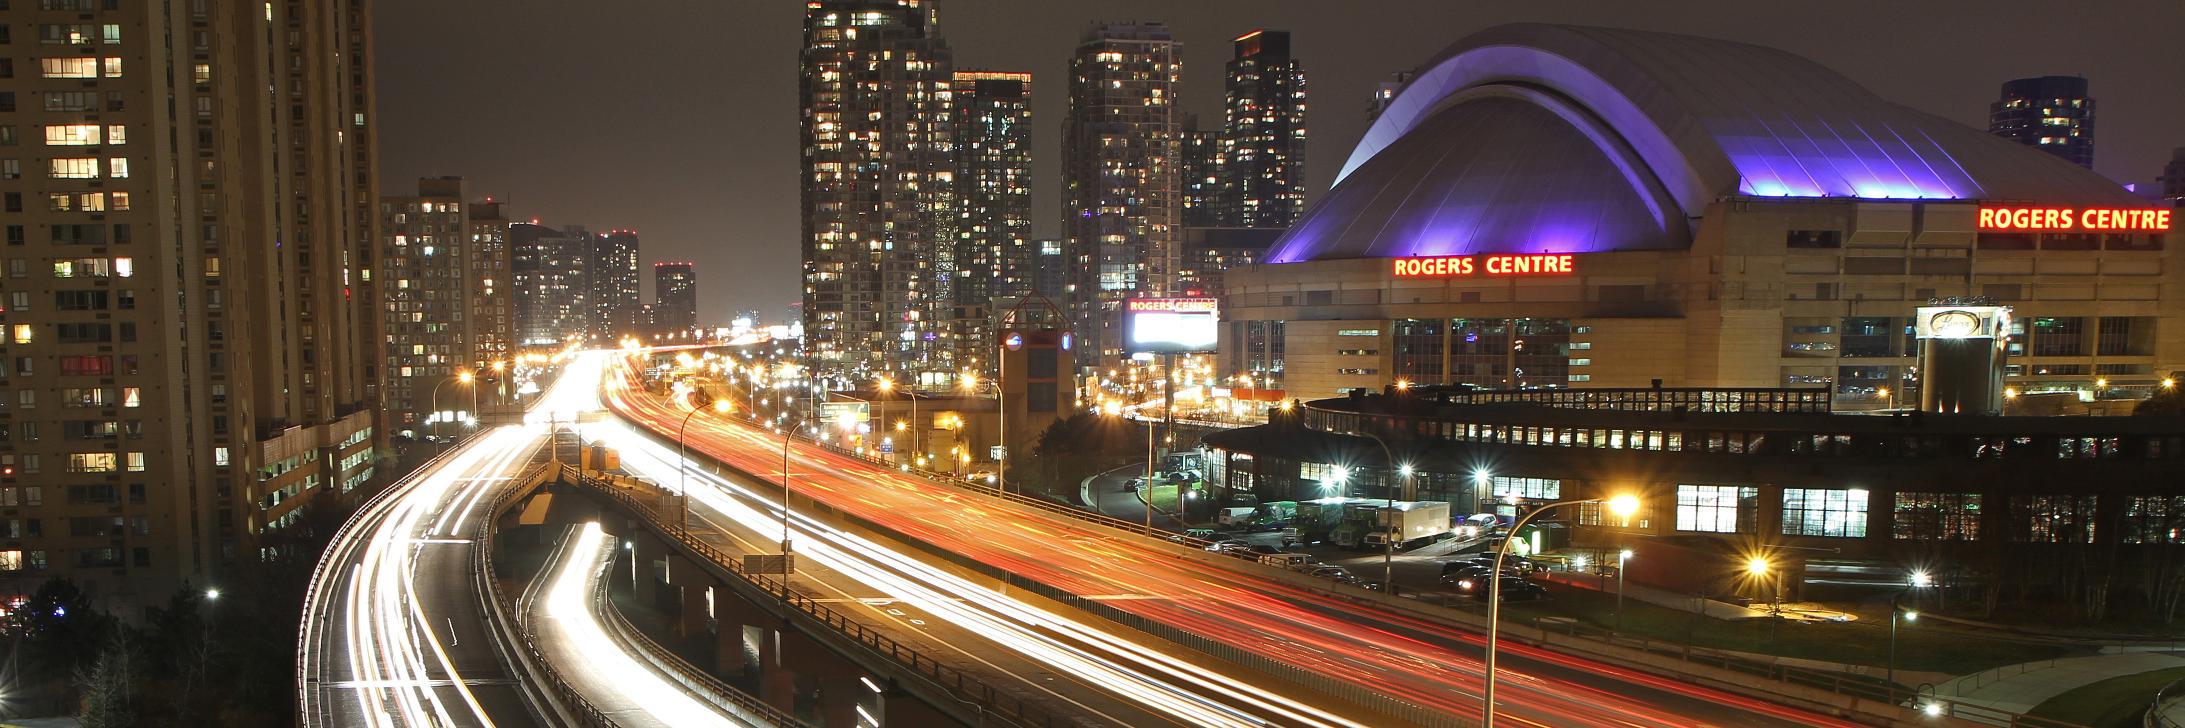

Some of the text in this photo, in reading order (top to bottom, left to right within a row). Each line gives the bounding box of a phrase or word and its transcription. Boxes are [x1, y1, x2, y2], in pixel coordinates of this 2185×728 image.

[1979, 208, 2170, 229] ROGERS CENTRE
[1394, 255, 1573, 276] ROGERS CENTRE
[1130, 301, 1216, 311] ROGERS CENTRE
